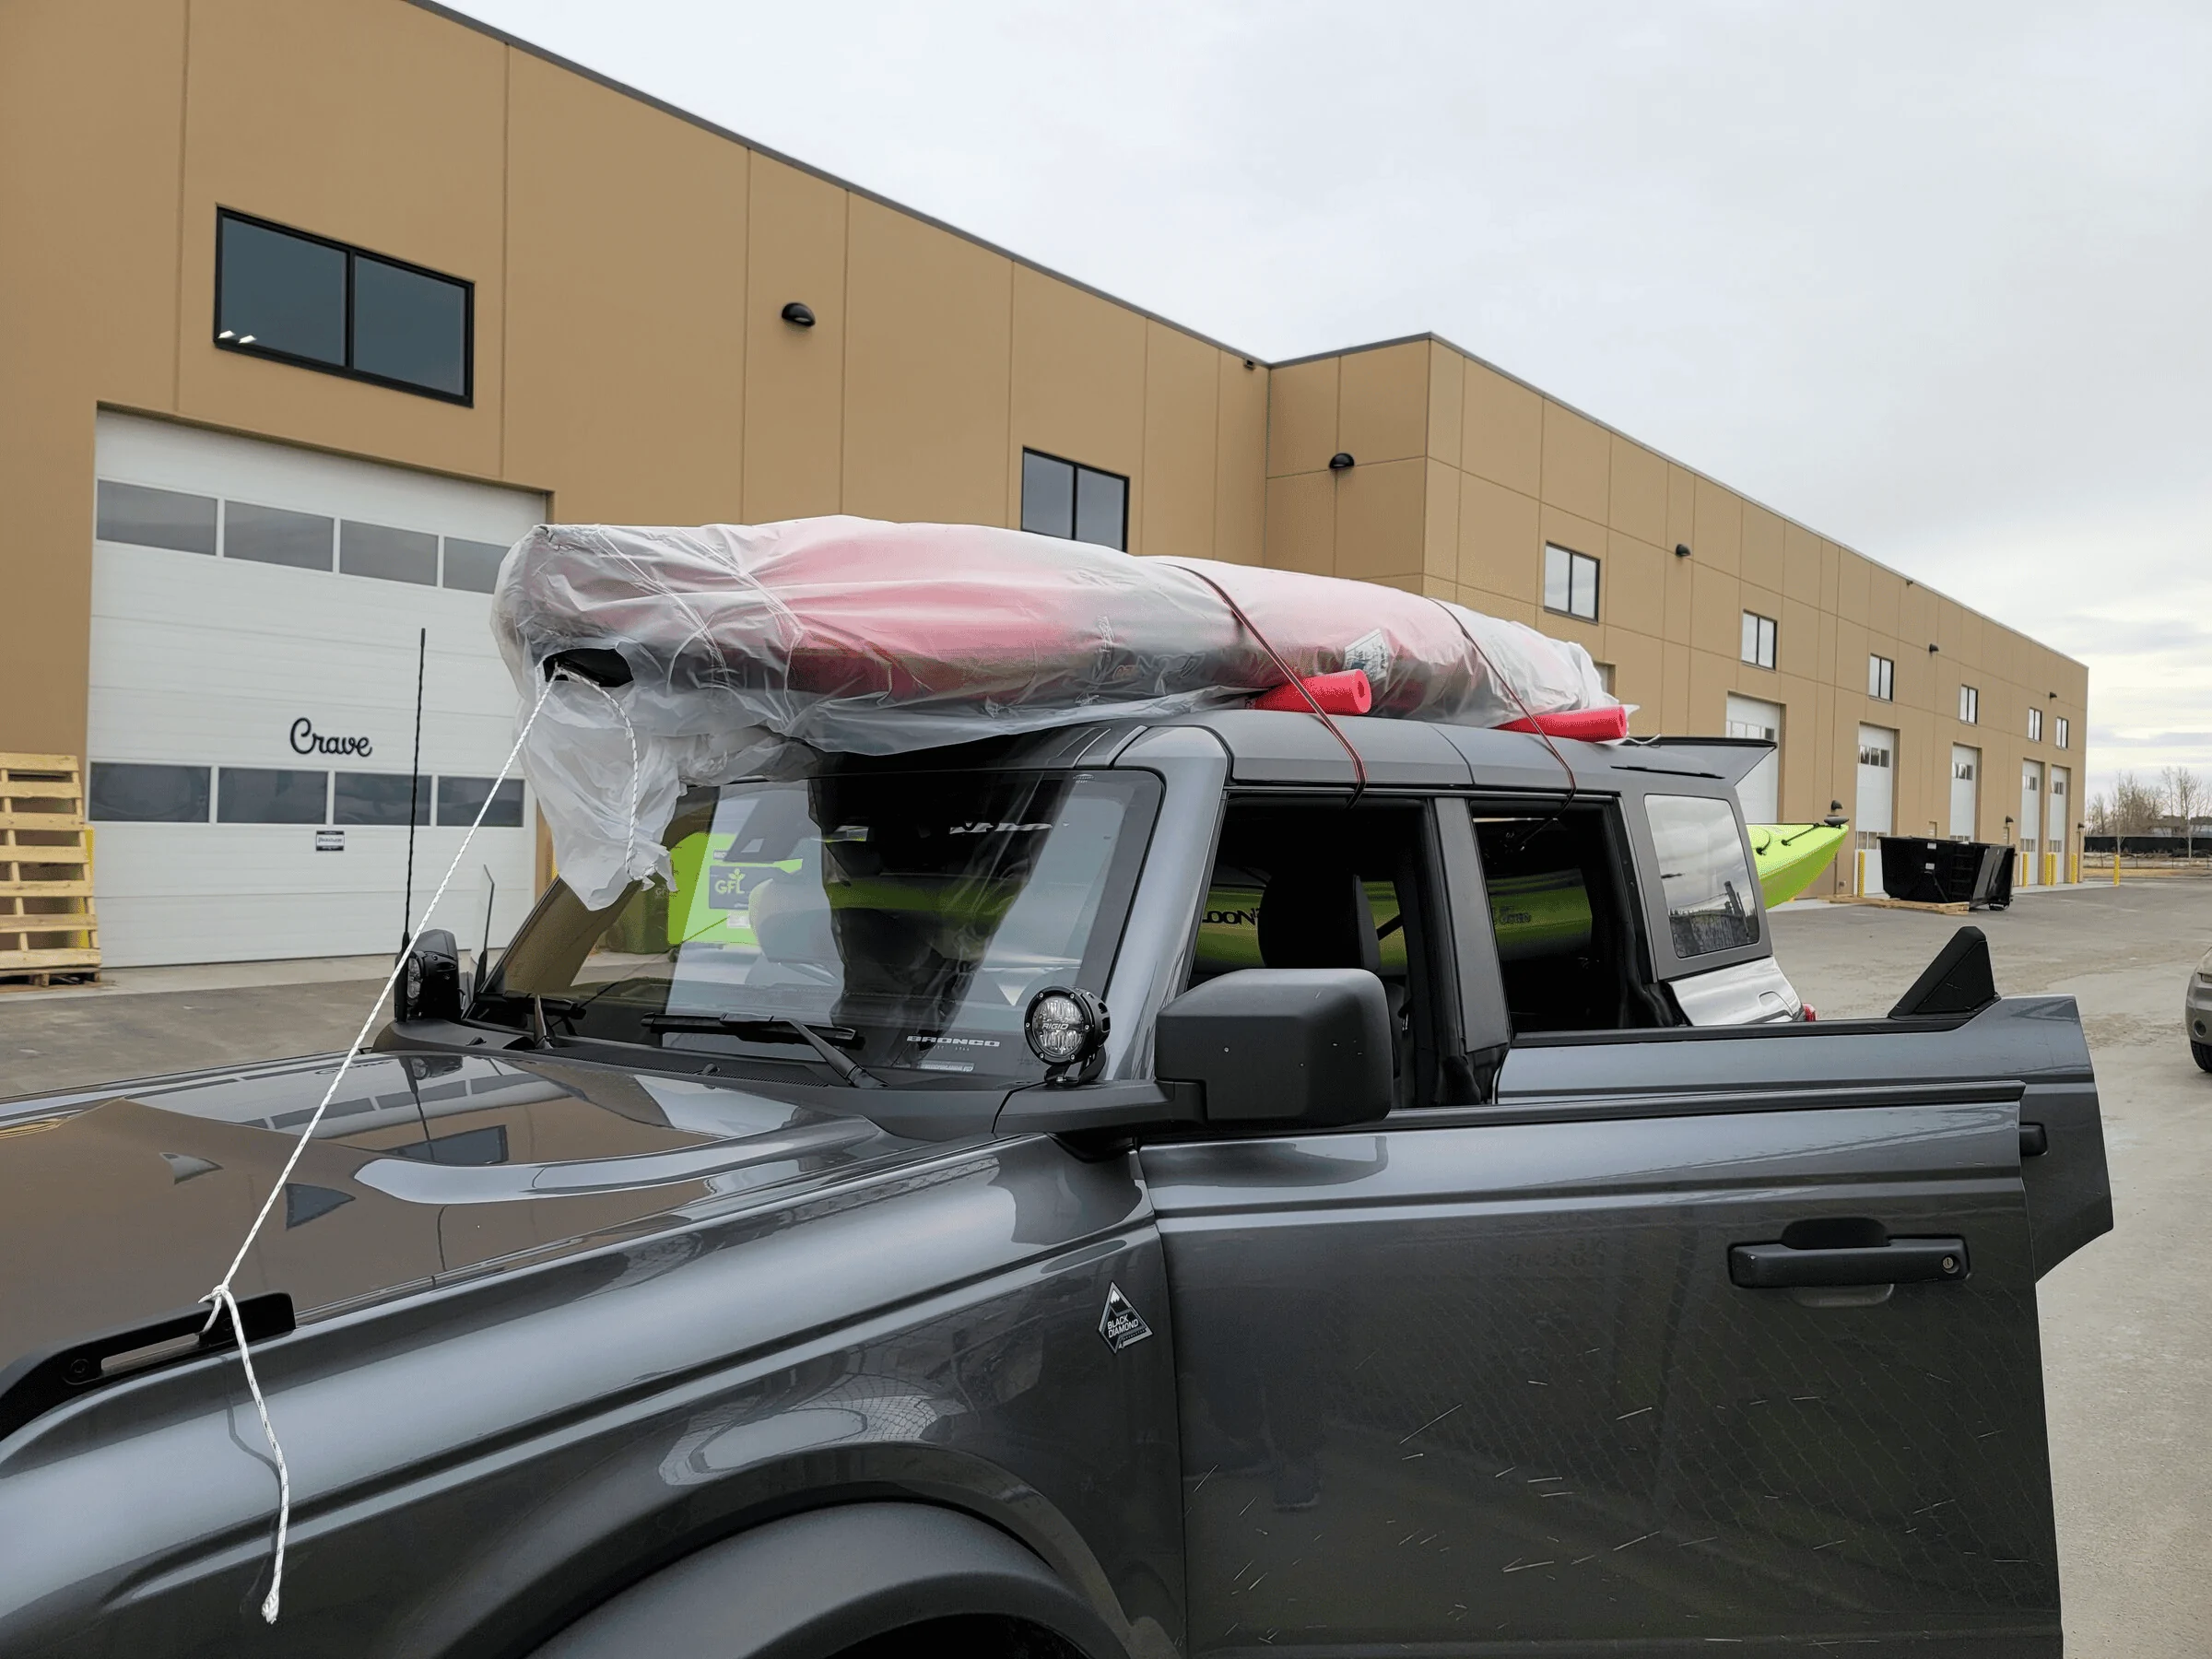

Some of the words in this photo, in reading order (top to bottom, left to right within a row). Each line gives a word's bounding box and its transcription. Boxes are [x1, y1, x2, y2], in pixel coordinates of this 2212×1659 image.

[289, 717, 373, 758] Crave
[714, 879, 746, 895] GFL
[1041, 1022, 1069, 1030] RIGID
[906, 1035, 1001, 1047] BRONCO
[1107, 1313, 1129, 1330] BLACK
[1108, 1318, 1139, 1338] DIAMOND
